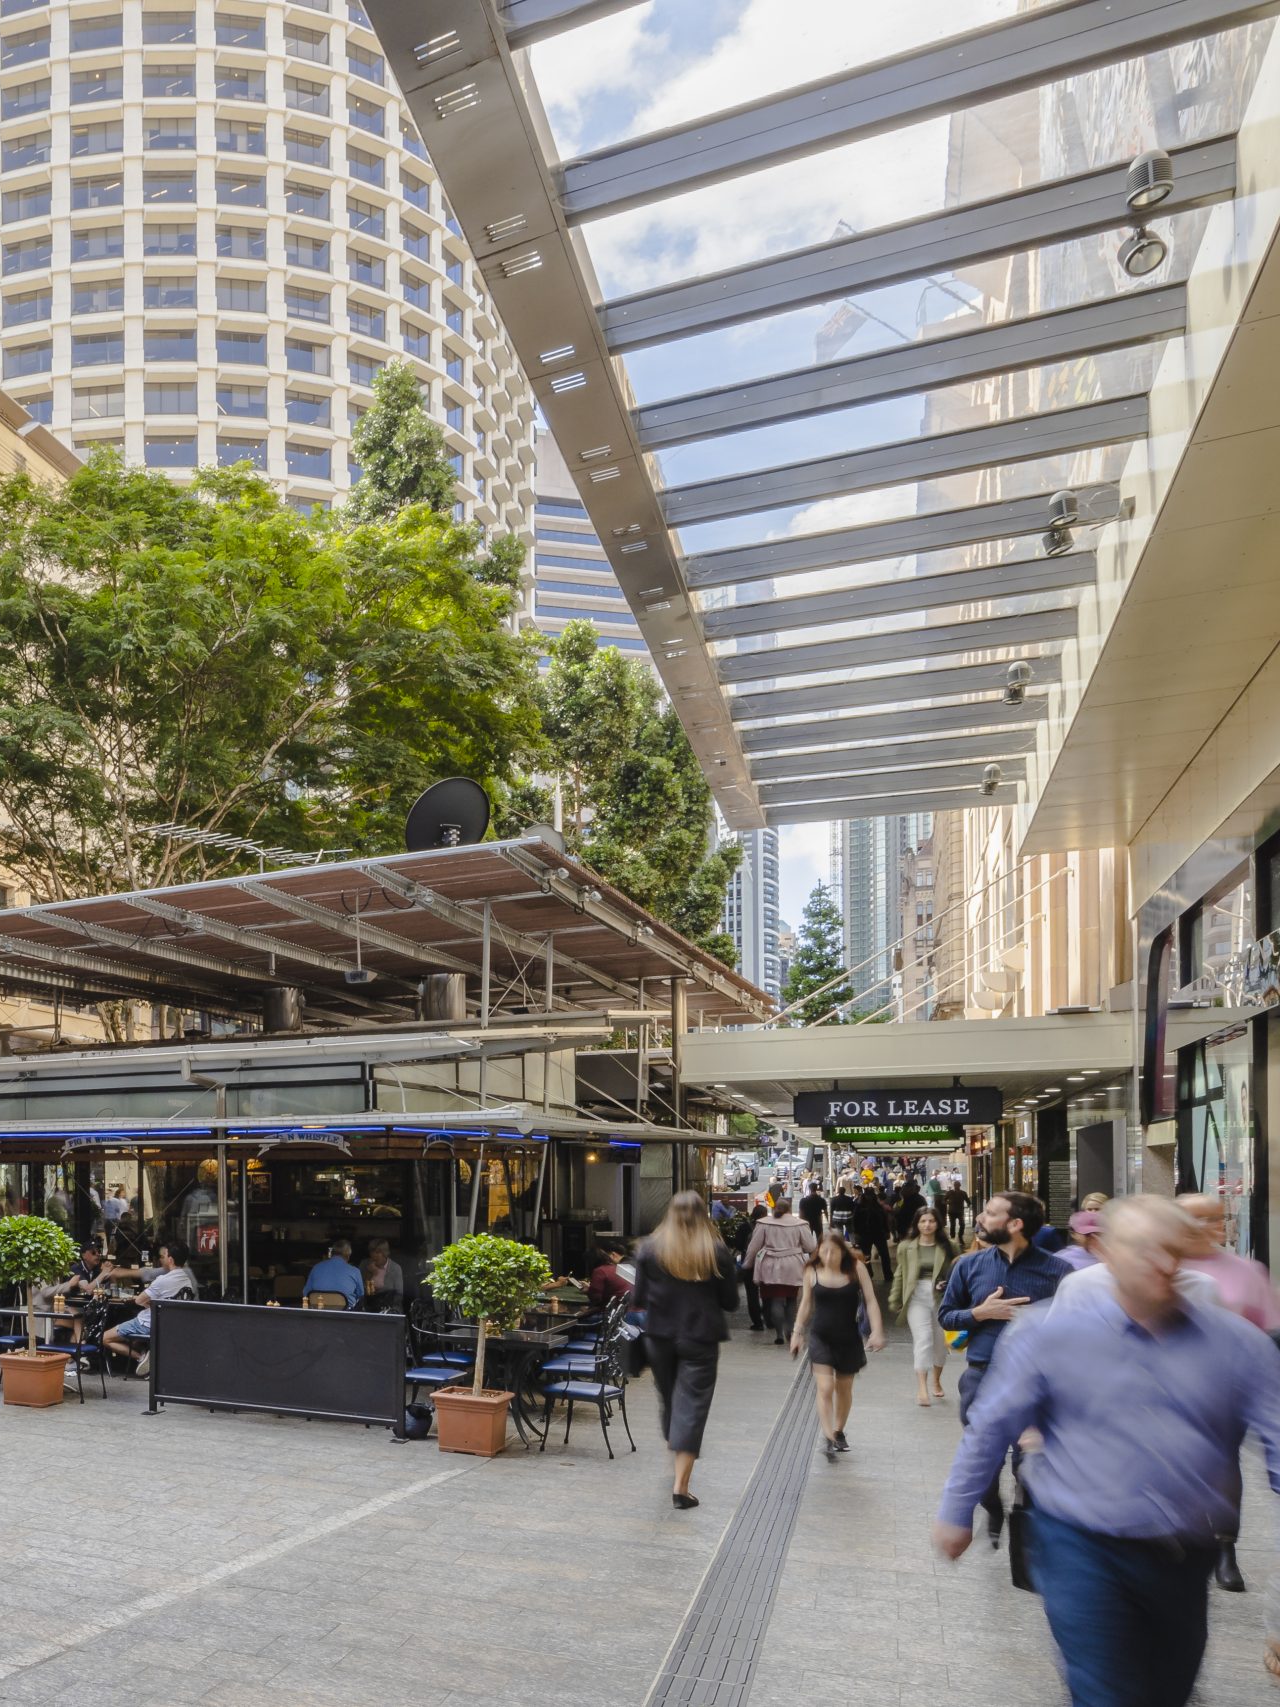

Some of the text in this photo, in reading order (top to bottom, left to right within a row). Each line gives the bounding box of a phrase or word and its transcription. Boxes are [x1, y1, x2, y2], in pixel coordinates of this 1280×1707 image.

[829, 1099, 970, 1117] FOR LEASE
[834, 1125, 949, 1134] TATTERSALL'S ARCADE
